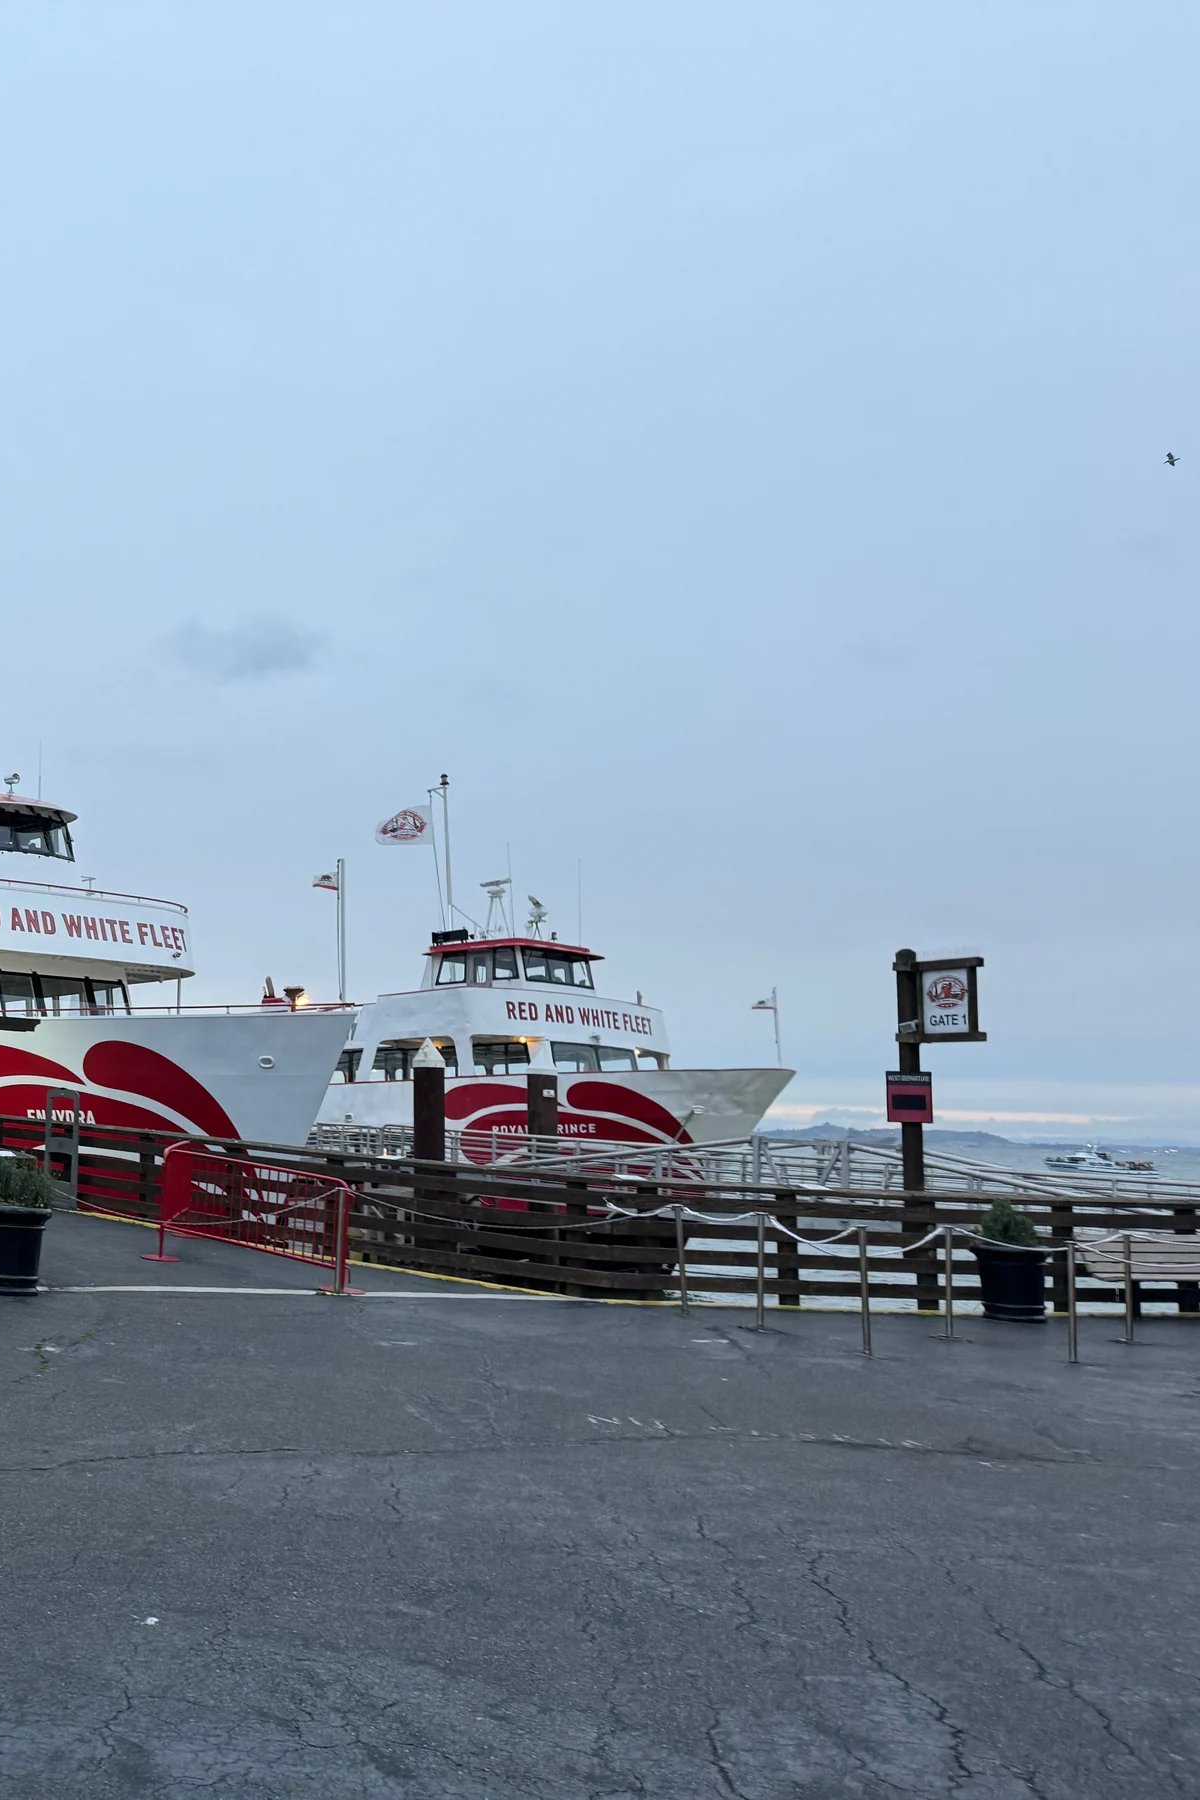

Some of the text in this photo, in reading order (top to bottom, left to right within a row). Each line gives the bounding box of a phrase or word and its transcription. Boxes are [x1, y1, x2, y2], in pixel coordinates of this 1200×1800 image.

[11, 907, 56, 935] AND
[62, 913, 133, 944] WHITE
[137, 922, 188, 952] FLEET
[505, 1001, 653, 1036] RED AND WHITE FLEET
[930, 1014, 967, 1026] GATE 1
[557, 1123, 597, 1135] RINCE
